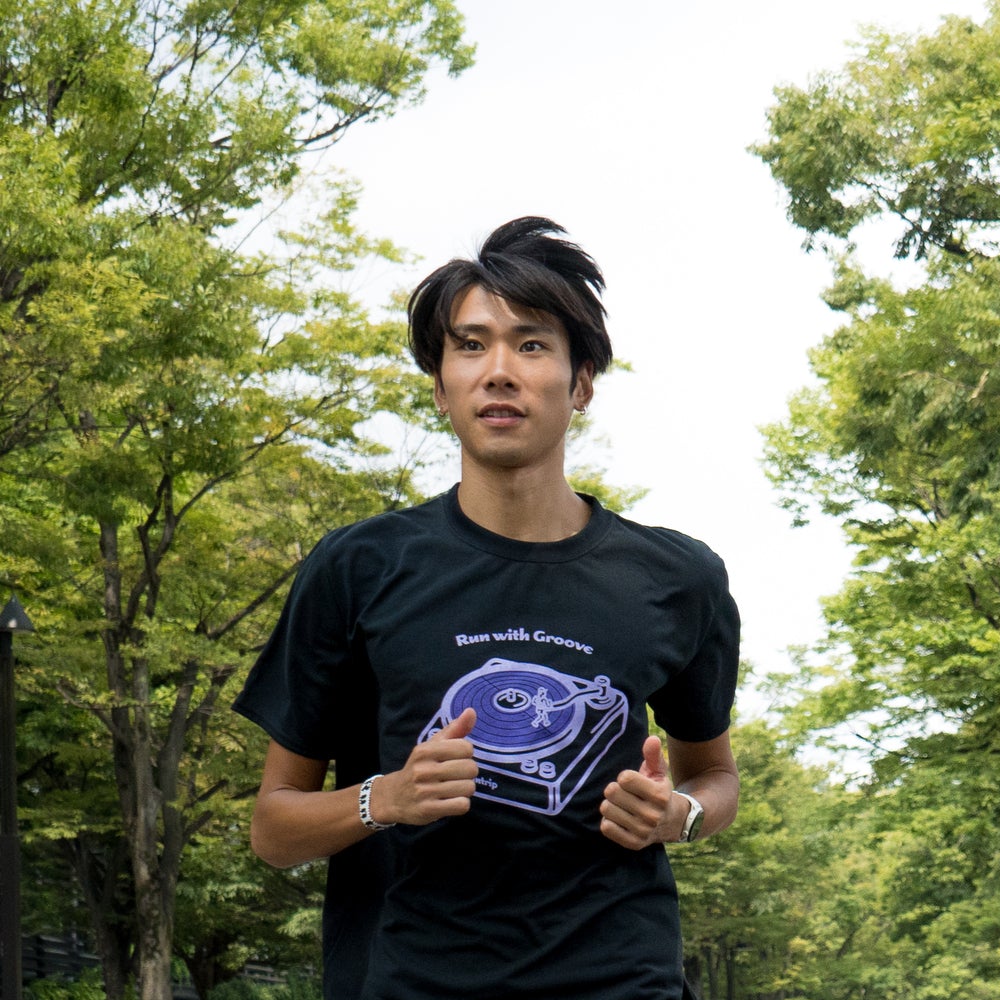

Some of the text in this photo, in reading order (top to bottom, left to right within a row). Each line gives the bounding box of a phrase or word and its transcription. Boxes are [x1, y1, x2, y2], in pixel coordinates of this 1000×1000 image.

[455, 627, 595, 655] Run with Groove
[473, 777, 498, 790] ntrip
